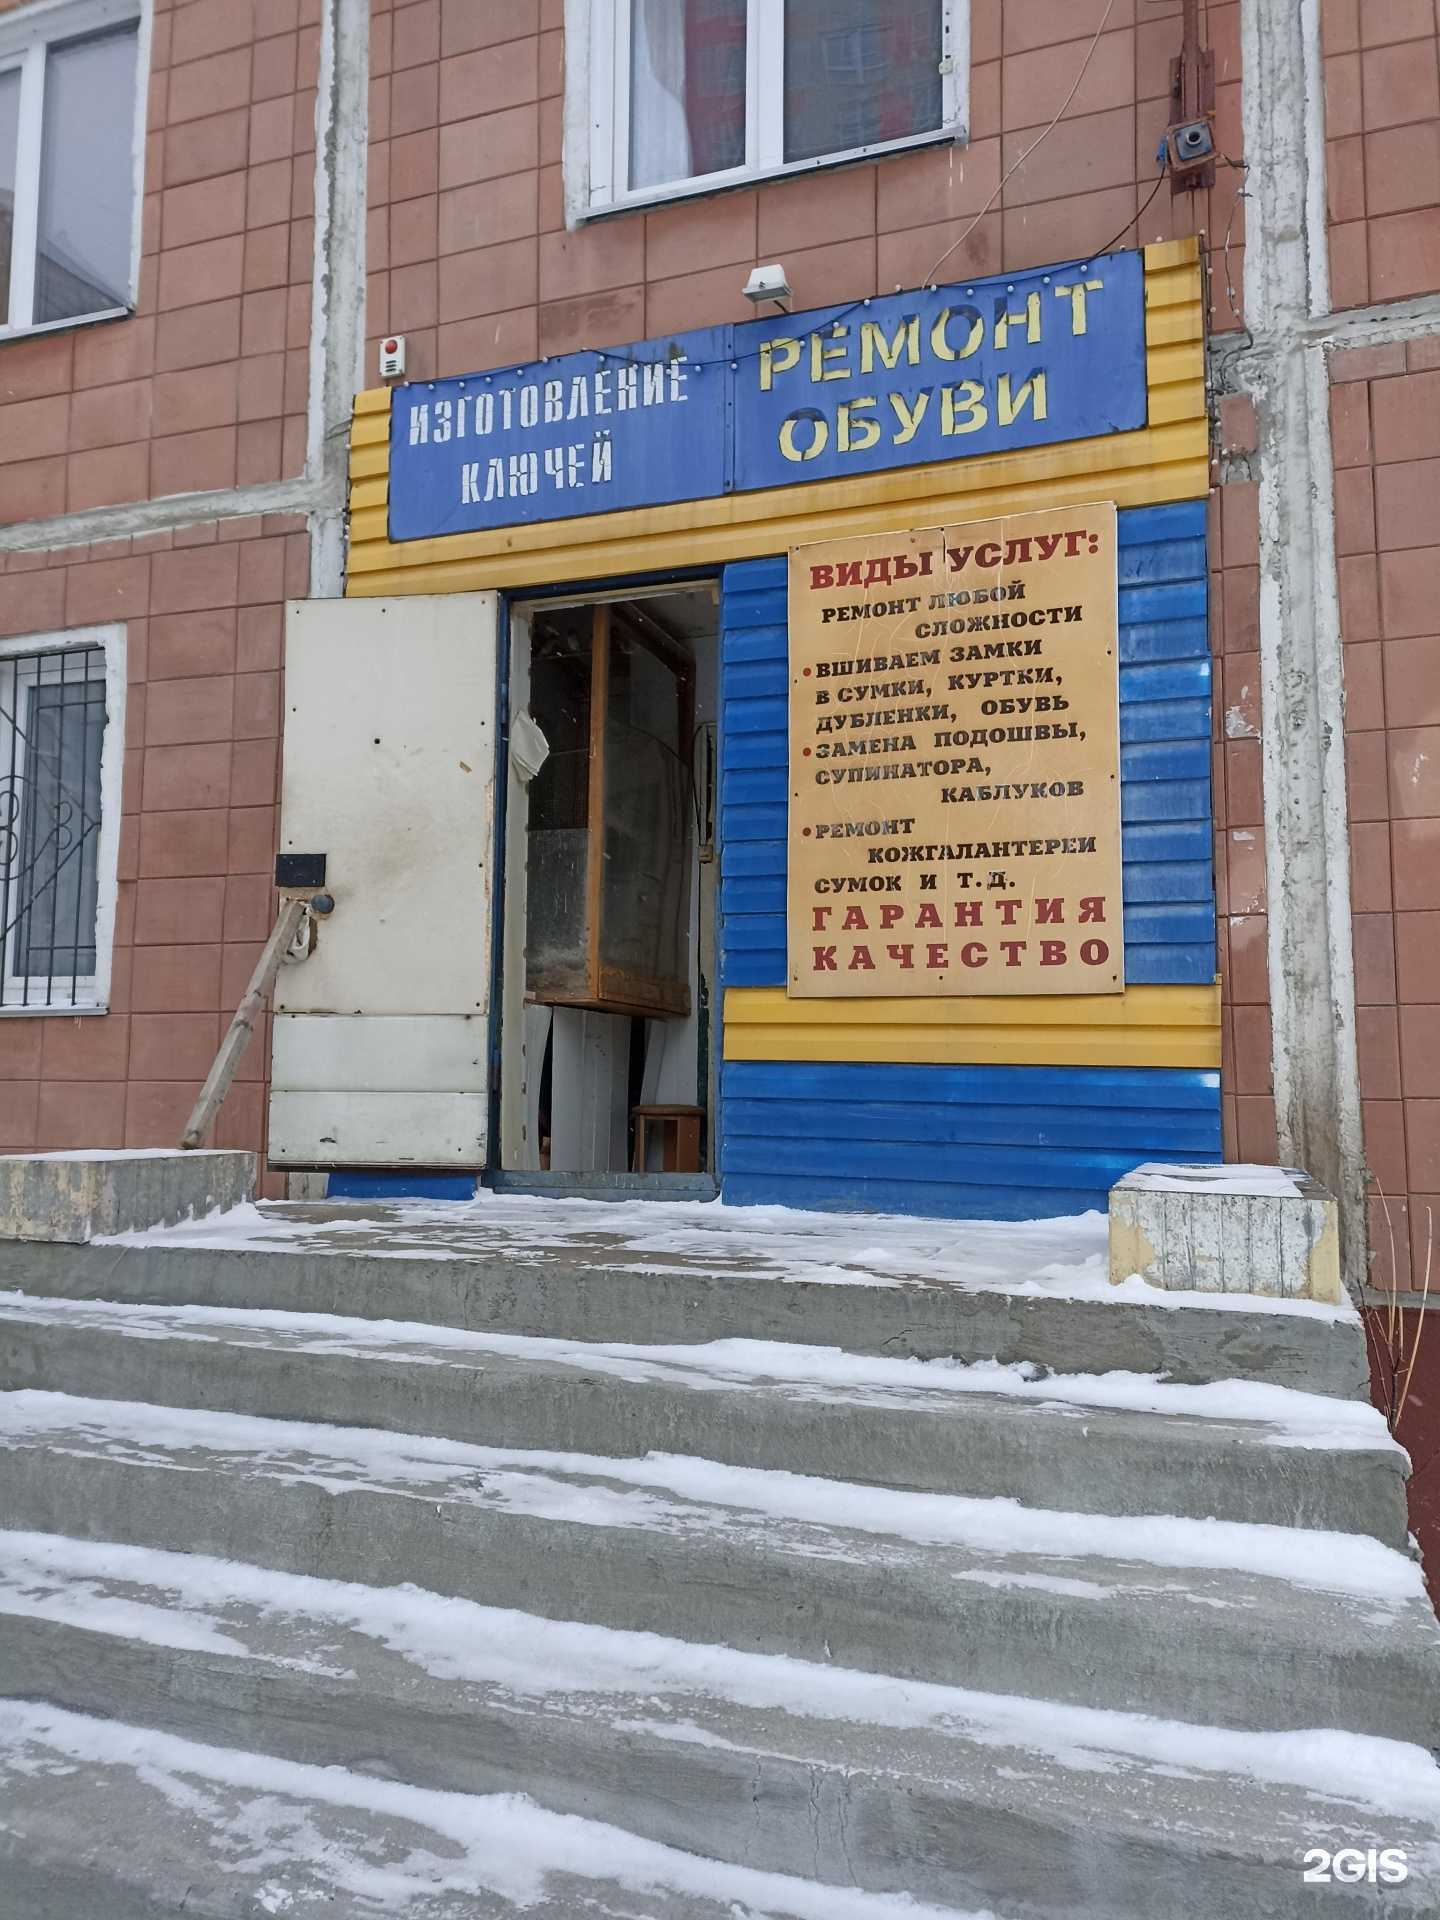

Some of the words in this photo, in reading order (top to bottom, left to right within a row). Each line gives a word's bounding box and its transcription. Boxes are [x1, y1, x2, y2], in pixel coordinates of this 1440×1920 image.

[759, 280, 1104, 391] РЕМОНТ
[409, 356, 688, 445] ИЗГОТОВЛЕНИЕ
[778, 367, 1048, 462] ОБУВИ
[461, 430, 612, 504] КЛЮЧЕЙ
[810, 551, 933, 590] ВИДЫ
[946, 529, 1099, 572] УСЛУГ:
[821, 596, 921, 623] РЕМОНТ
[928, 580, 1026, 609] ЛЮБОЙ
[915, 605, 1083, 639] СЛОЖНОСТИ
[815, 649, 940, 679] ВШИВАЕМ
[949, 639, 1042, 662] ЗАМКИ
[815, 690, 830, 705] В
[838, 678, 932, 703] СУМКИ,
[947, 667, 1063, 691] КУРТКИ,
[816, 704, 957, 735] ДУБЛЕНКИ,
[981, 695, 1069, 716] ОБУВЬ
[815, 735, 917, 759] ЗАМЕНА
[933, 722, 1086, 749] ПОДОШВЫ,
[815, 757, 992, 786] СУПИНАТОРА,
[941, 781, 1085, 804] КАБЛУКОВ
[815, 818, 916, 839] РЕМОНТ
[814, 875, 902, 894] СУМОК
[919, 874, 938, 890] И
[811, 896, 1106, 932] ГАРАНТИЯ
[811, 938, 1110, 971] КАЧЕСТВО
